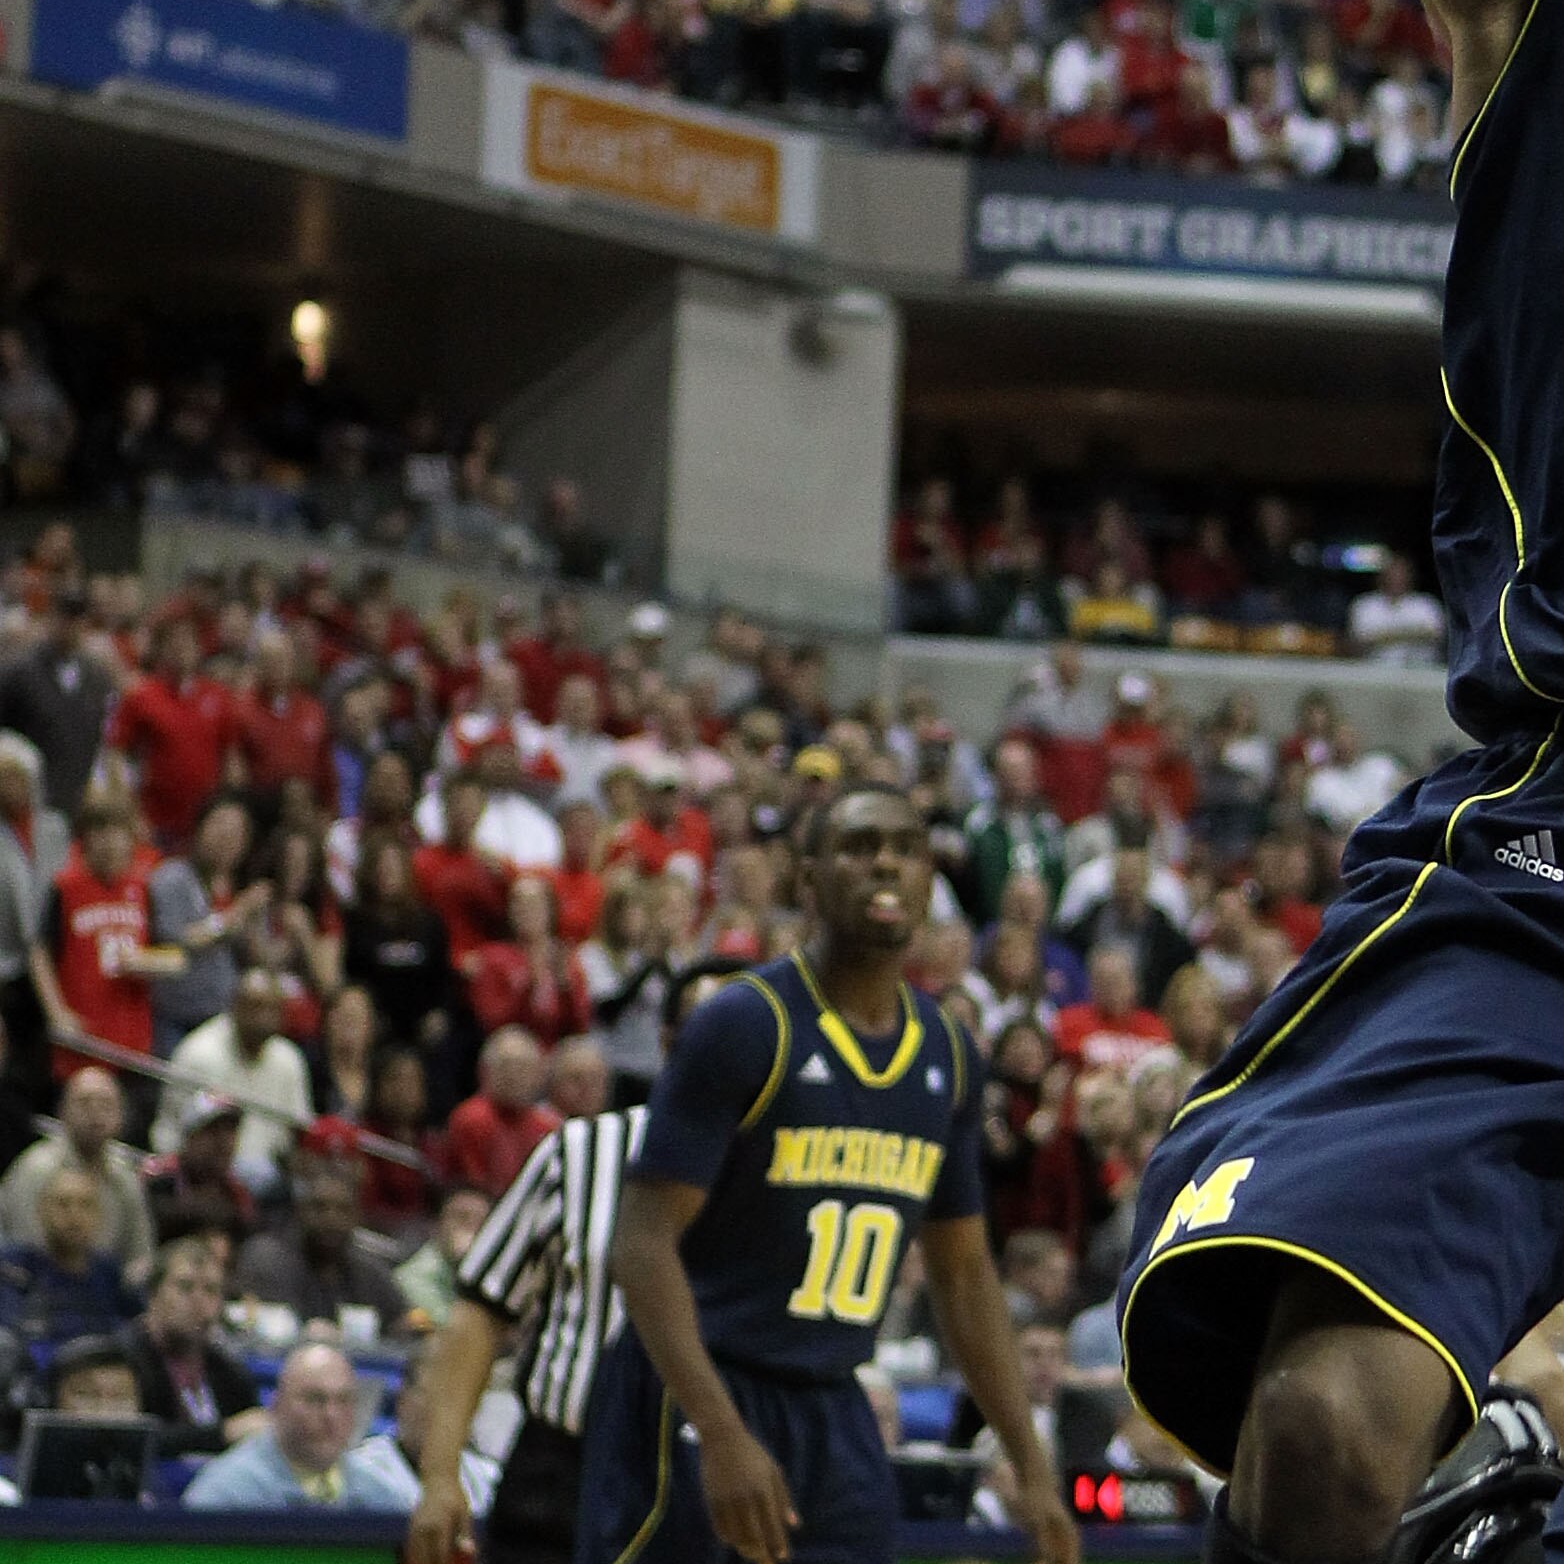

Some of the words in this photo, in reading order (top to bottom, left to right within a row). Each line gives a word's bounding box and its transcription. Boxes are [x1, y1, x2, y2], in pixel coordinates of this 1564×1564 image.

[978, 194, 1174, 262] SPORT
[767, 1126, 945, 1200] MICHIGAN
[1147, 1156, 1256, 1260] M
[787, 1199, 903, 1327] 10
